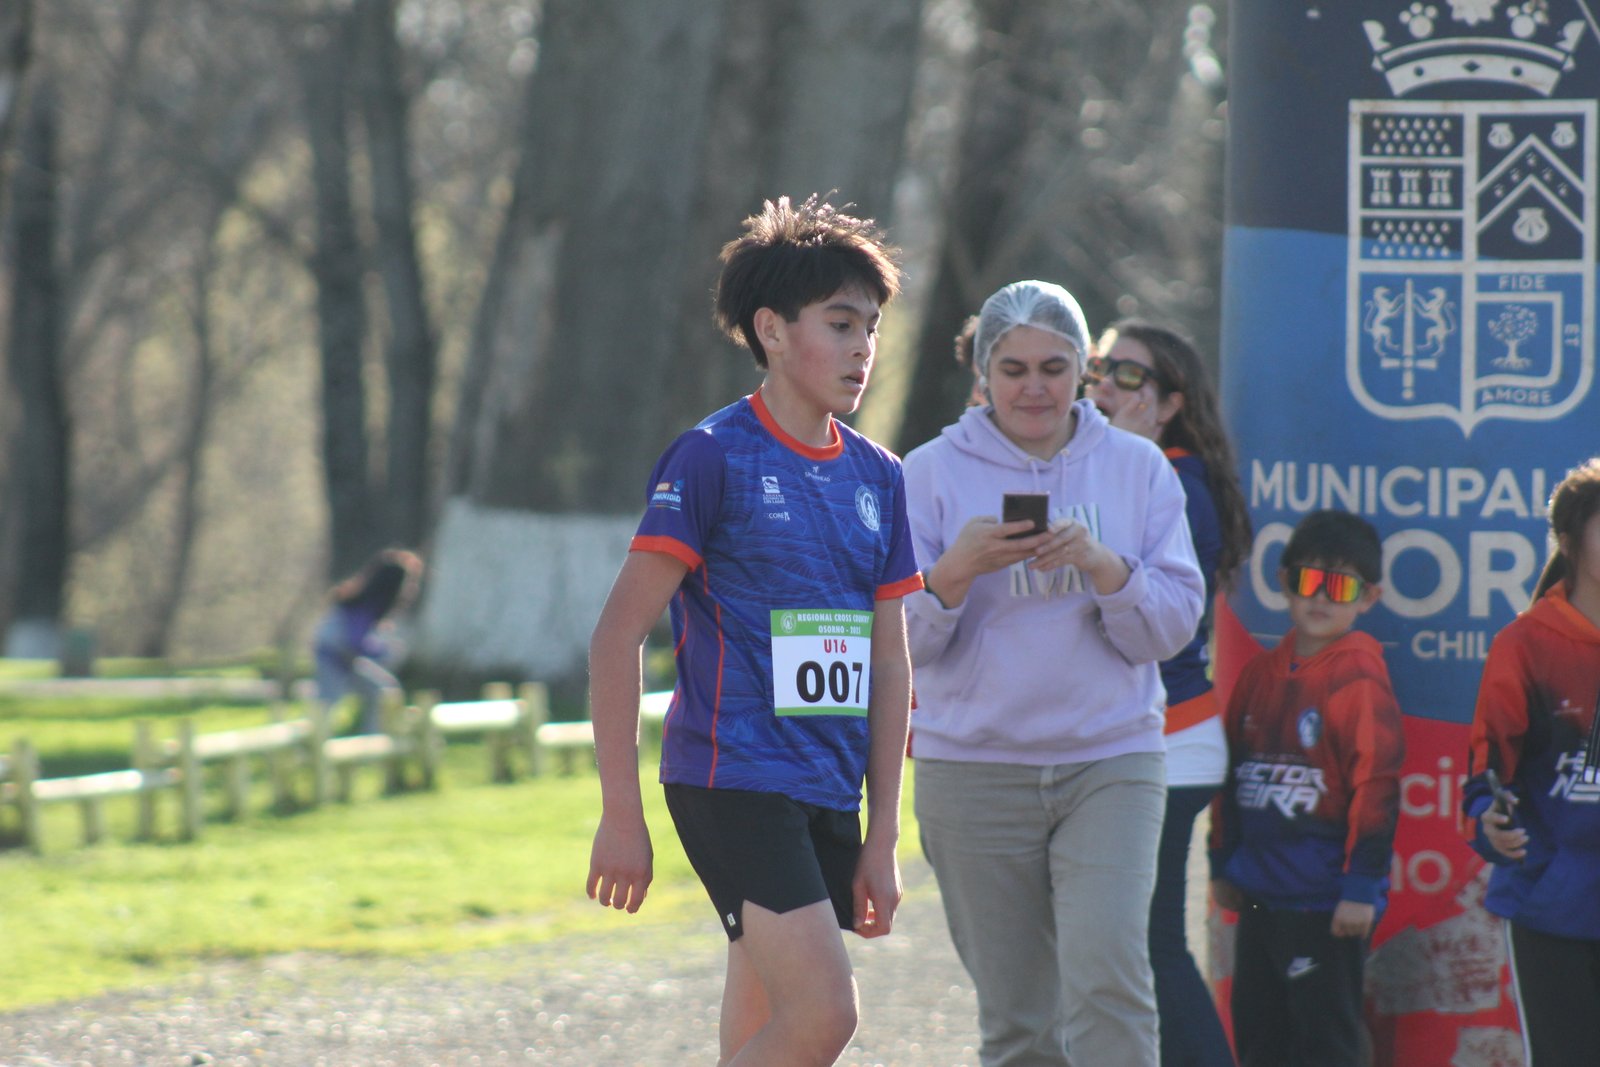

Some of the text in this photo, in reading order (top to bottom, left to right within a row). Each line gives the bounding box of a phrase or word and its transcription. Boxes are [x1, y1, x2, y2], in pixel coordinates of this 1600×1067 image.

[1498, 275, 1547, 290] FIDE
[1481, 387, 1552, 404] AMORE
[1251, 459, 1550, 518] MUNICIPAL
[797, 613, 833, 622] REGIONAL
[834, 614, 852, 622] CROSS
[818, 625, 845, 634] OSORNO
[824, 639, 847, 654] U16
[1411, 630, 1488, 659] CHIL
[796, 660, 863, 703] 007
